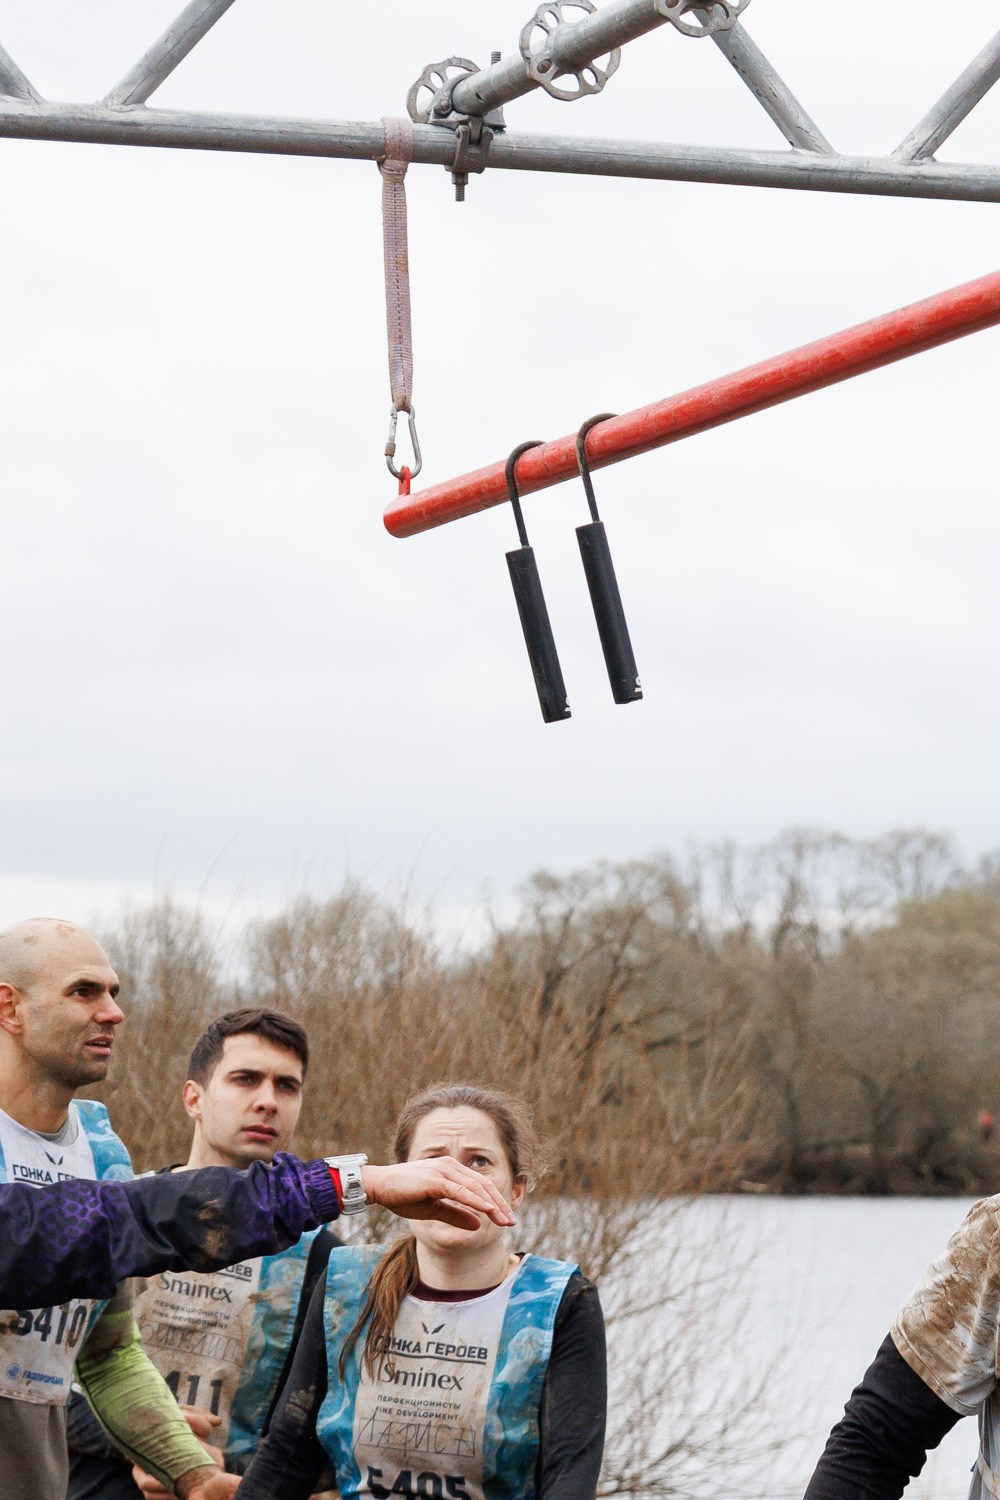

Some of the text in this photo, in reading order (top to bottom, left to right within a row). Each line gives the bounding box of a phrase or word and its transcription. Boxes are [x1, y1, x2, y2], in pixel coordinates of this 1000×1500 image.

[12, 1164, 53, 1183] ГОНКА
[157, 1271, 233, 1303] Sminex
[426, 1341, 488, 1360] ГЕРОЕВ
[381, 1361, 465, 1391] Sminex
[377, 1394, 461, 1410] ПЕРФЕКЦИОНИСТЫ
[376, 1406, 459, 1421] FINE DEVELOPMENT
